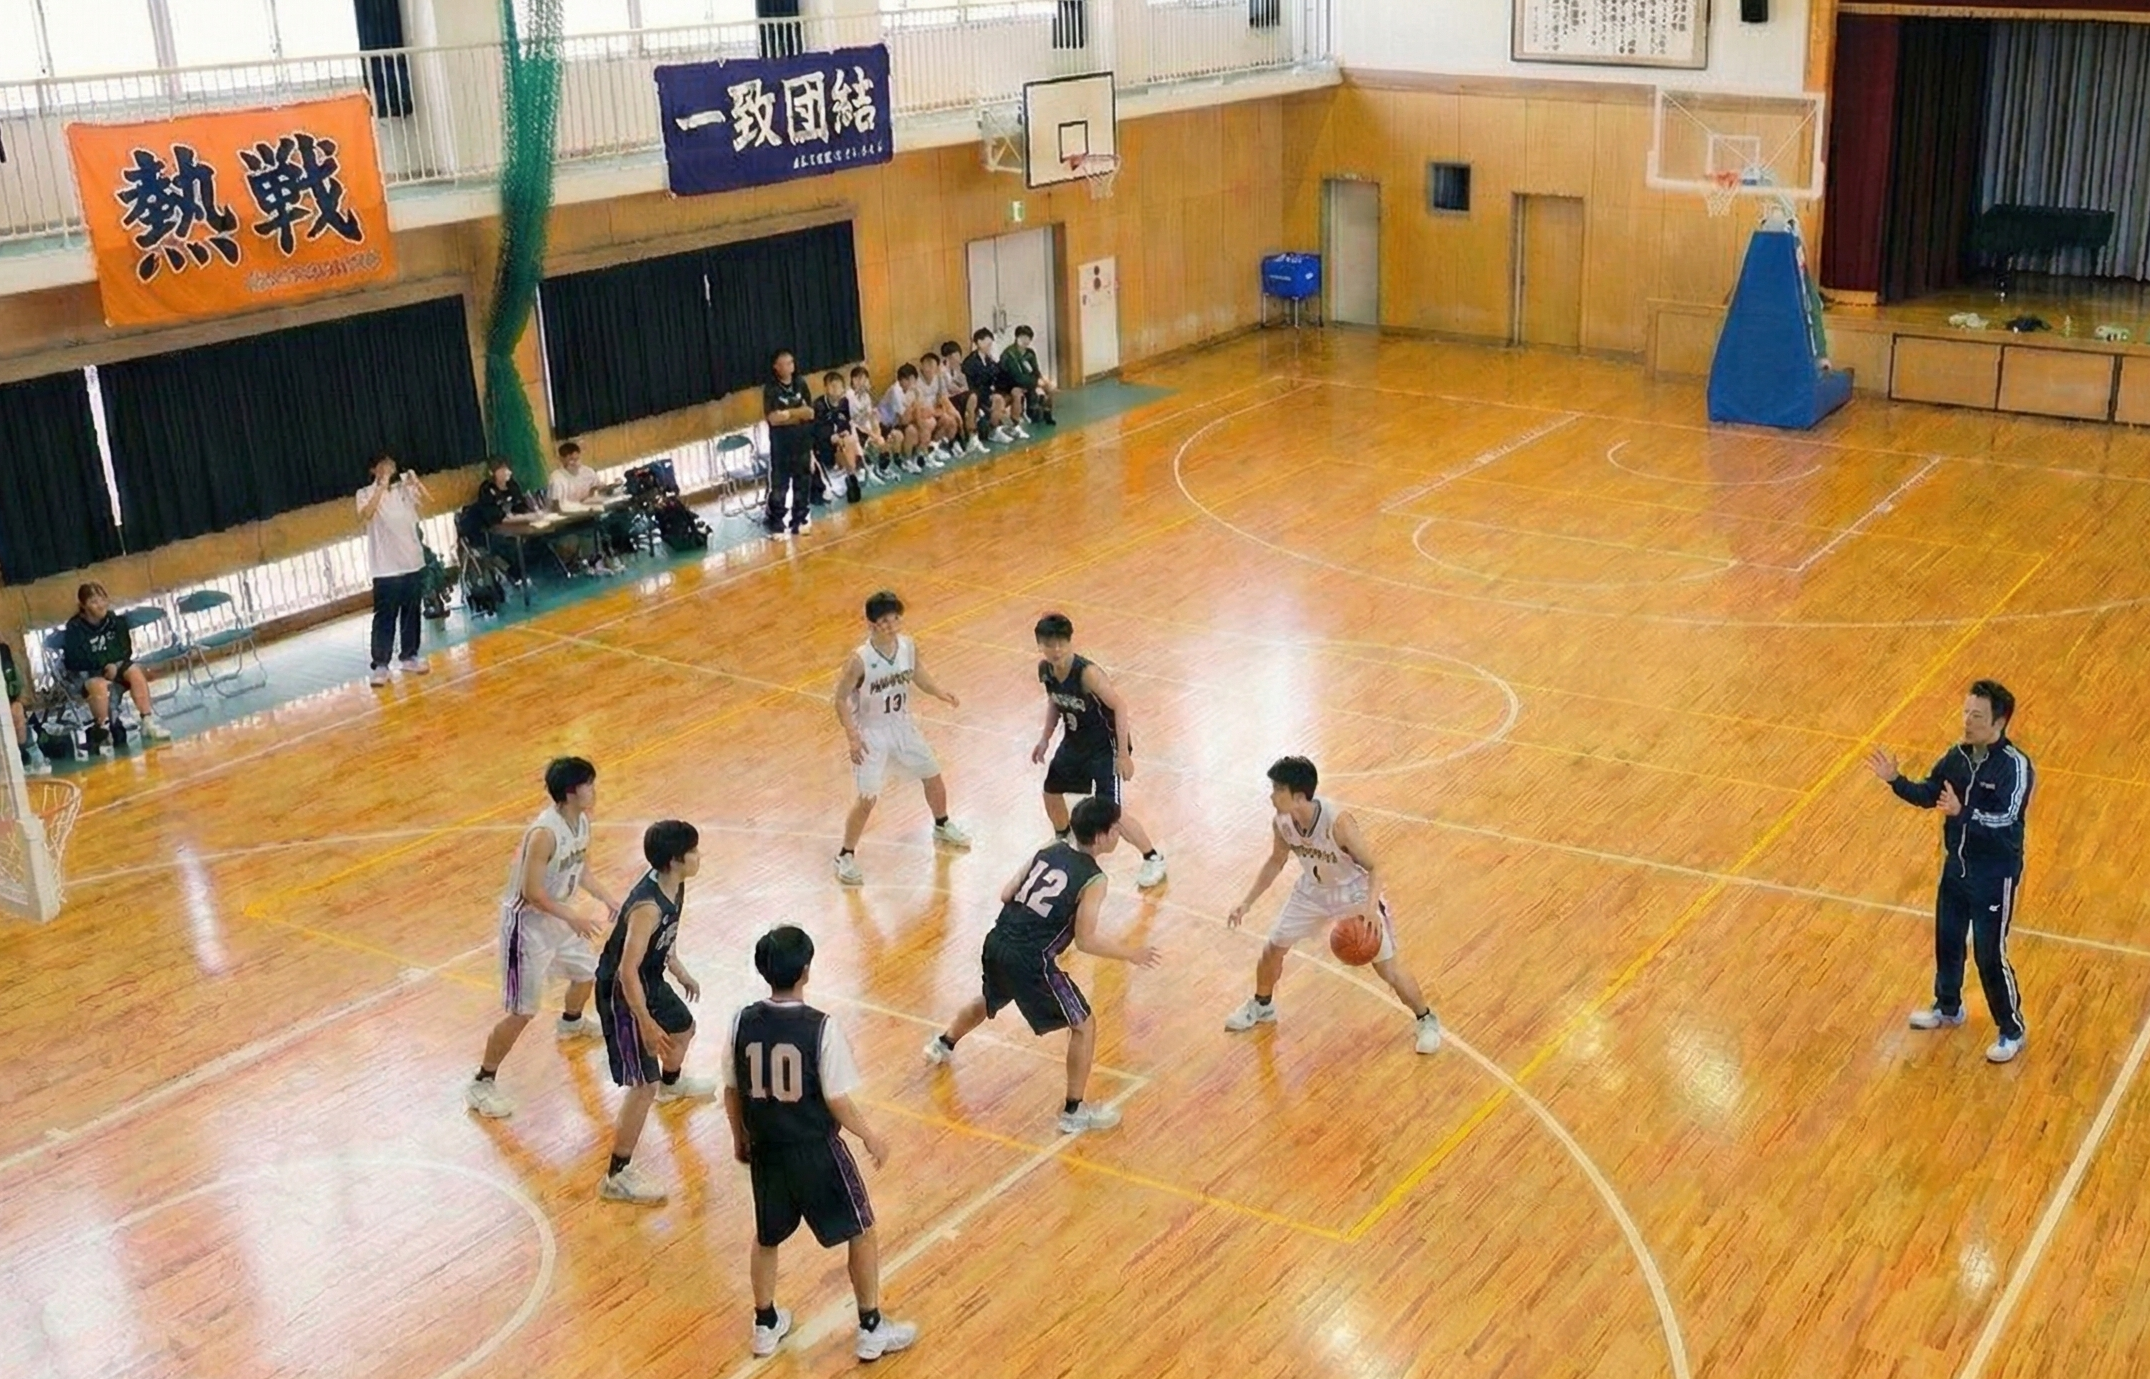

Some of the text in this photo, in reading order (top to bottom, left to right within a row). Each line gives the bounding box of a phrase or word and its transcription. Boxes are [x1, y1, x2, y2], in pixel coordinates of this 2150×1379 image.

[675, 66, 876, 152] 一致団結
[116, 131, 364, 283] 熱戦
[884, 693, 902, 714] 13
[1014, 860, 1068, 918] 12
[745, 1042, 803, 1103] 10
